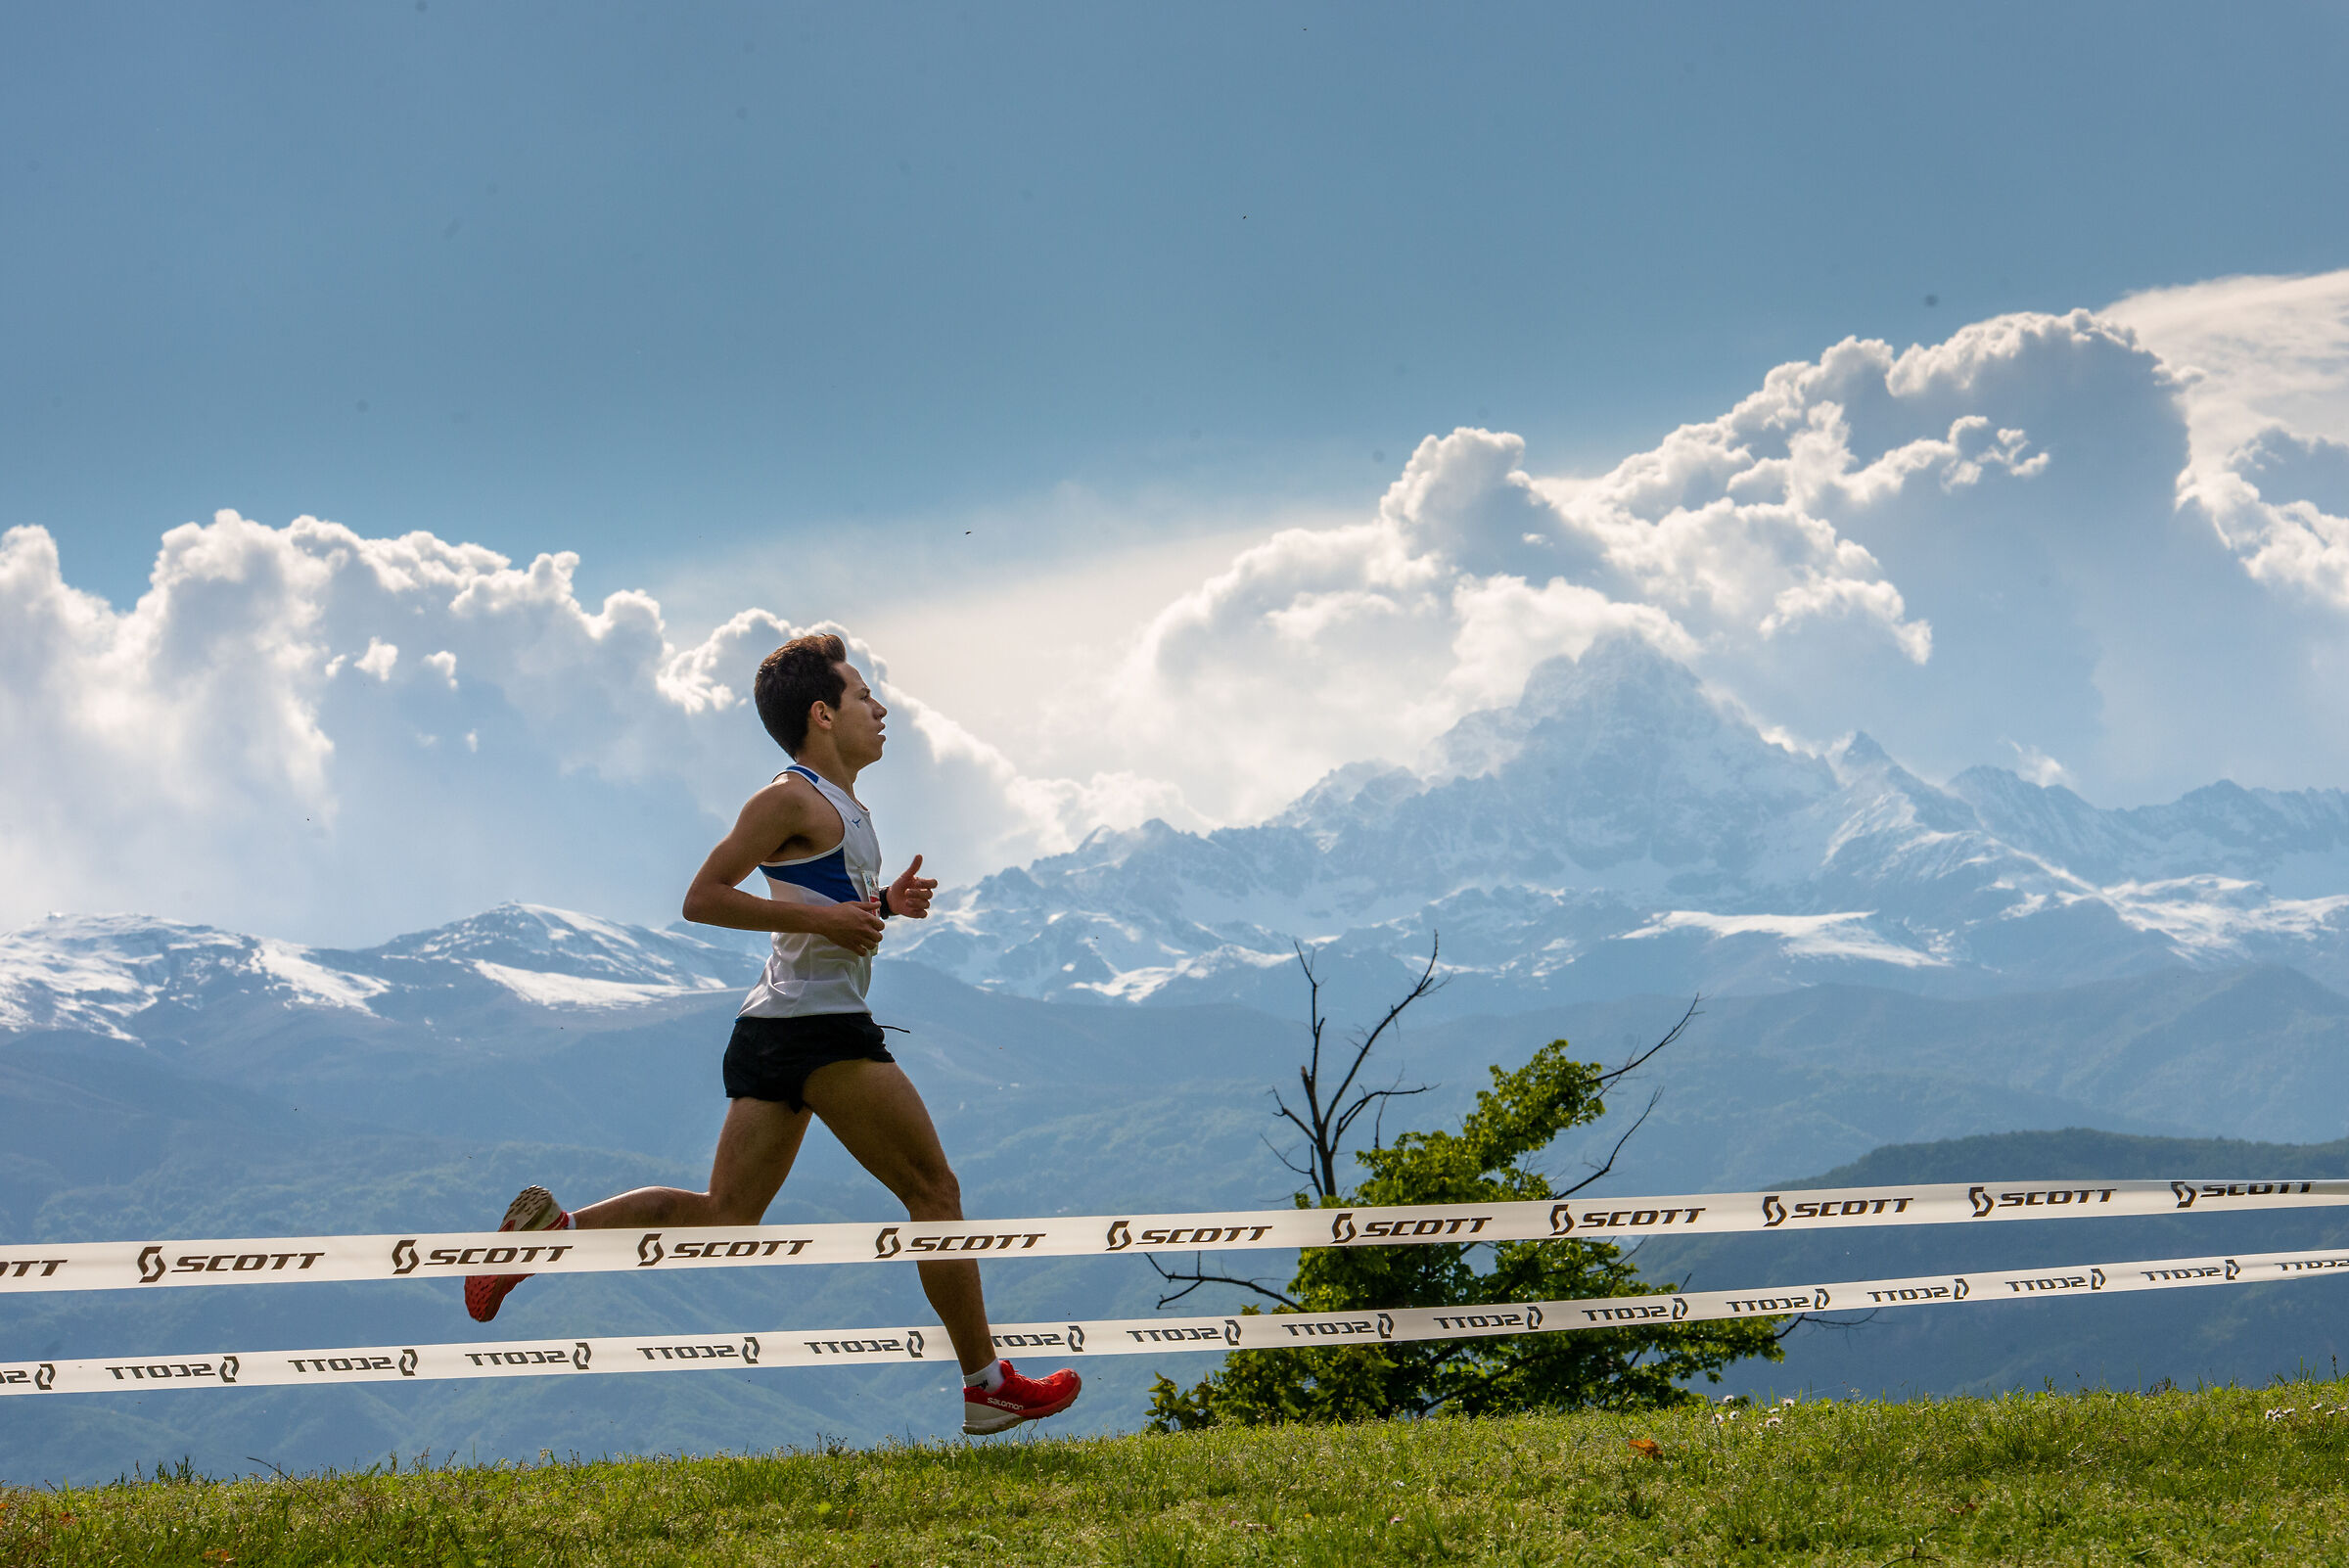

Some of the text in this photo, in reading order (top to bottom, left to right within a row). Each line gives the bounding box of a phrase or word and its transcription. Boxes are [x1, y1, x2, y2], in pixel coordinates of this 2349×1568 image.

[1997, 1187, 2118, 1208] SCOTT
[2199, 1180, 2317, 1198] SCOTT
[1577, 1207, 1707, 1229] SCOTT
[1790, 1197, 1914, 1220] SCOTT
[1135, 1225, 1273, 1245] SCOTT
[1359, 1217, 1494, 1238] SCOTT
[668, 1239, 814, 1260] SCOTT
[904, 1233, 1047, 1253] SCOTT
[170, 1252, 326, 1273] SCOTT
[423, 1245, 574, 1267] SCOTT
[0, 1259, 69, 1277] TT
